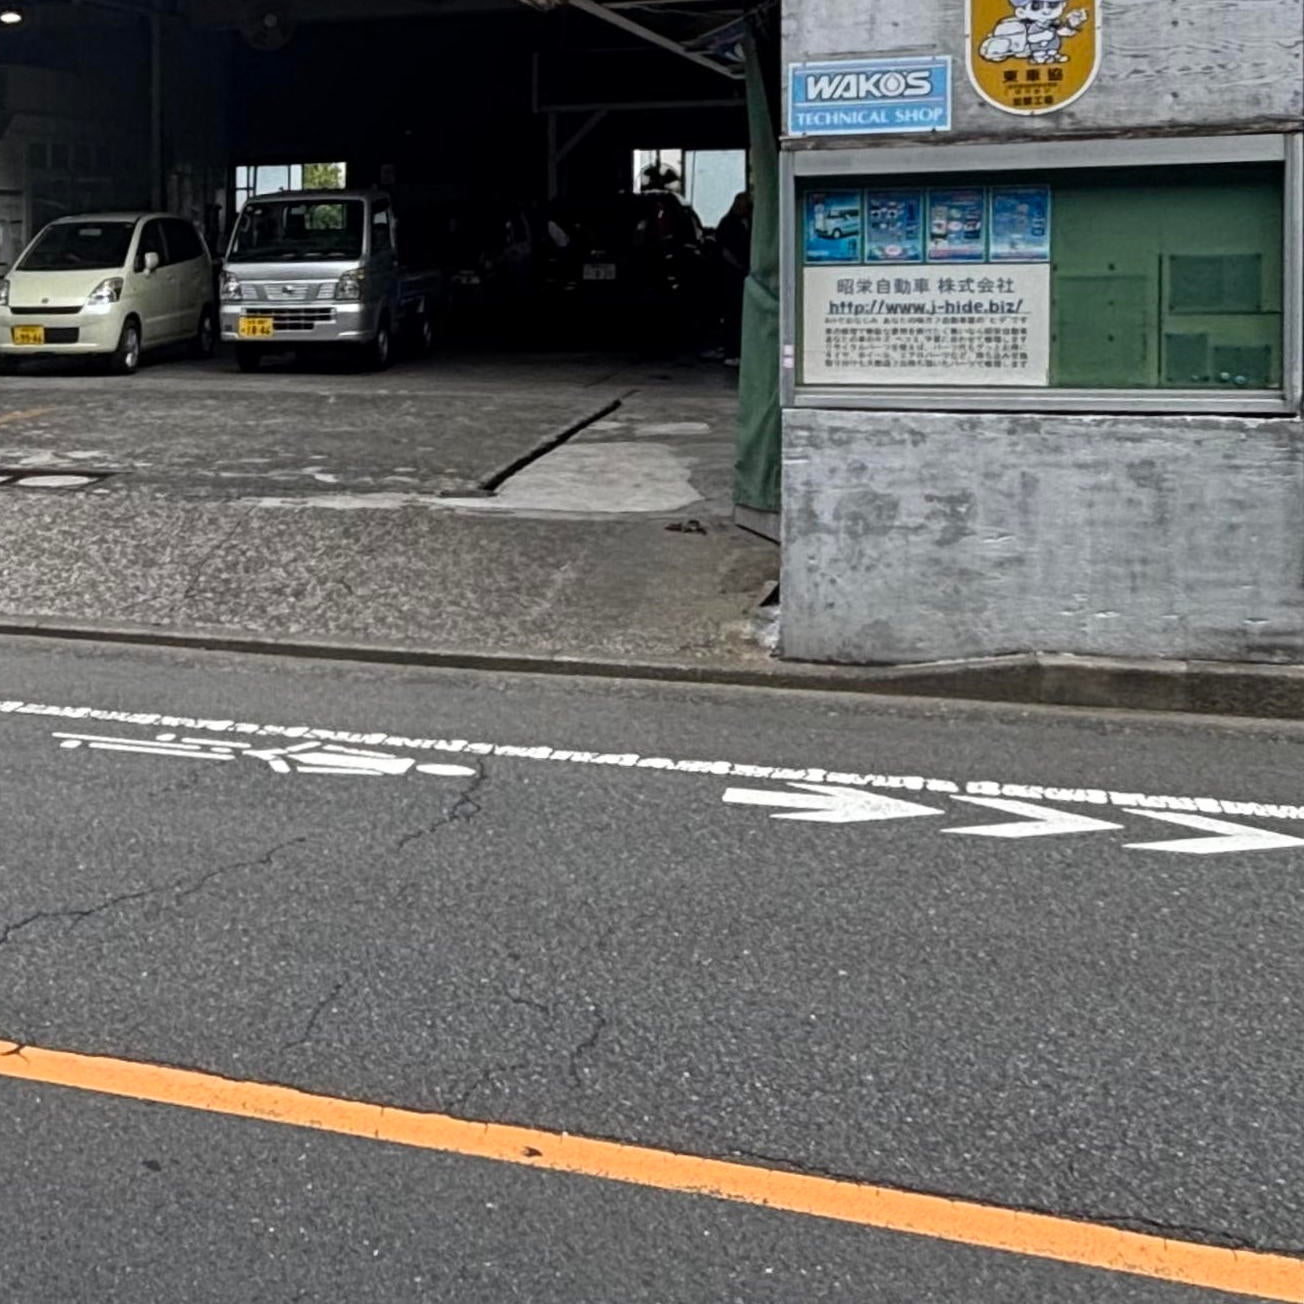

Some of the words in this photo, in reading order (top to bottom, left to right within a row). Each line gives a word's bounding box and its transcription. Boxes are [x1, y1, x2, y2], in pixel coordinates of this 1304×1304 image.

[797, 110, 888, 126] TECHNICAL
[895, 107, 943, 123] SHOP
[837, 278, 930, 295] 昭栄自動車
[938, 277, 1015, 295] 株式会社
[829, 299, 1024, 315] http://www.j-hide.biz/
